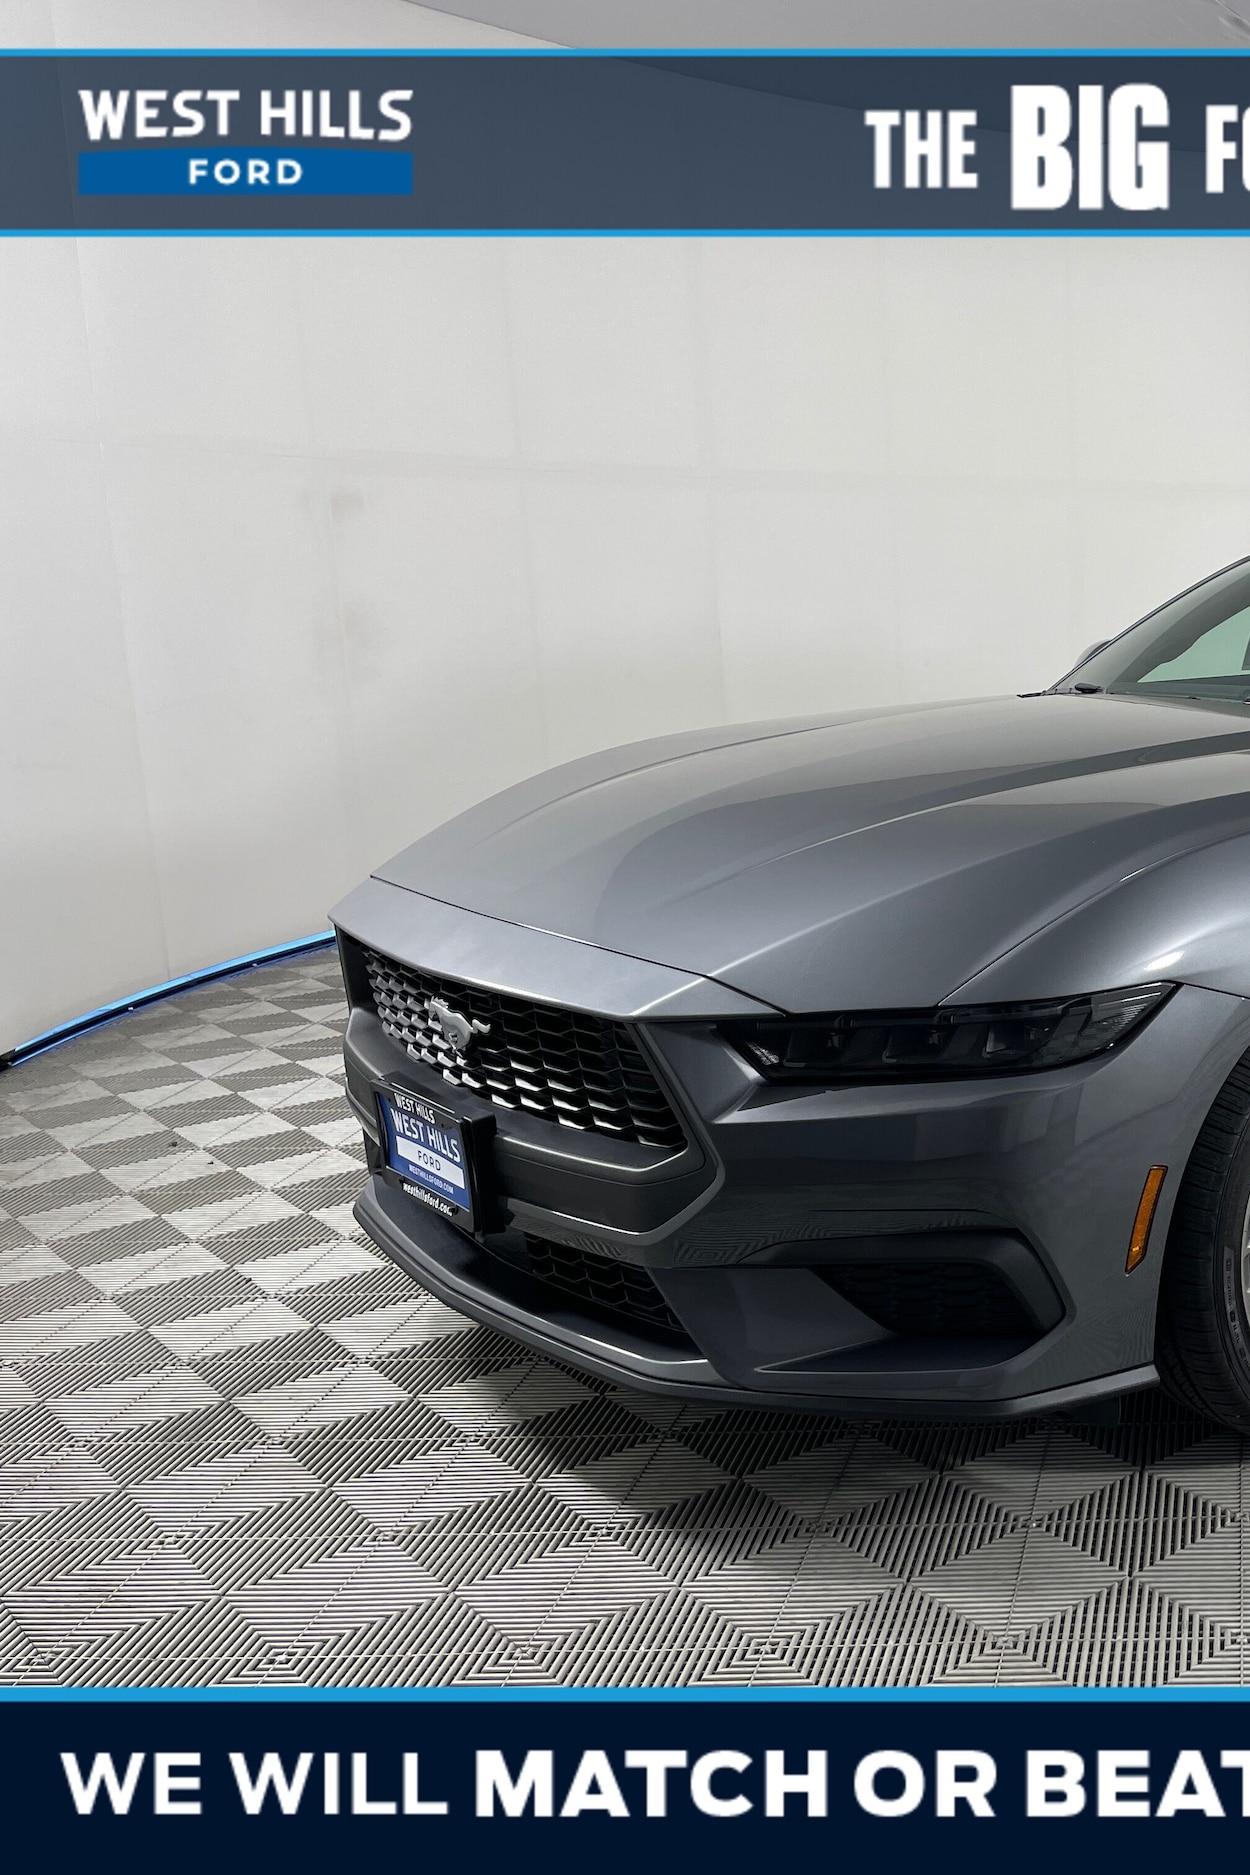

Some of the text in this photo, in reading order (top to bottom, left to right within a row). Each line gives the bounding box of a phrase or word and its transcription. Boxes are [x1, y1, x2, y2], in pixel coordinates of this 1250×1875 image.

[394, 1092, 436, 1124] WEST HILLS
[390, 1107, 461, 1163] WEST HILLS
[417, 1150, 441, 1171] FORD
[408, 1163, 454, 1195] WESTHILLSFORD.COM
